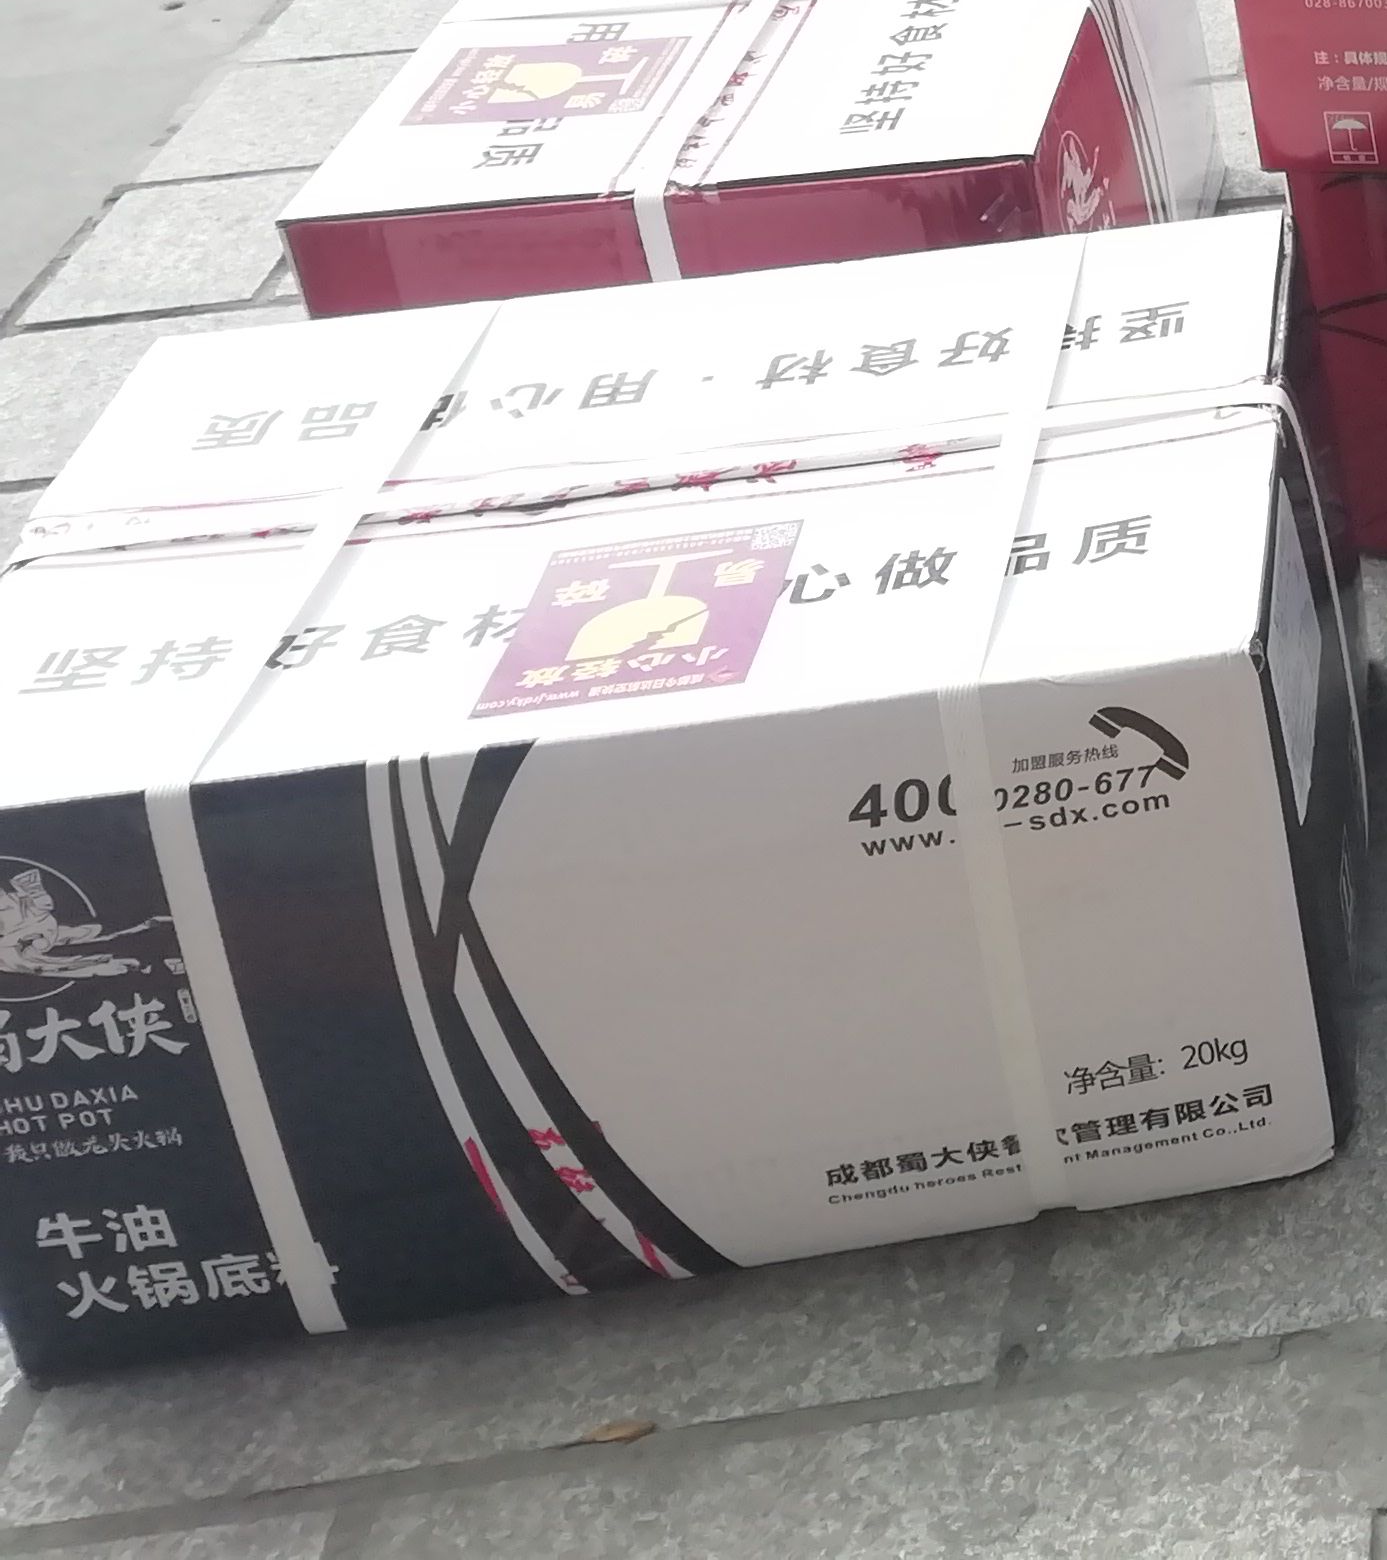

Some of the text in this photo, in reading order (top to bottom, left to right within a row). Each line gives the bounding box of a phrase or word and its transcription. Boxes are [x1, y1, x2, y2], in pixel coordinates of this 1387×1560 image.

[515, 644, 730, 688] 小心轻放
[1011, 744, 1120, 775] 加盟服务热线
[1181, 1036, 1250, 1073] 20kg
[0, 1083, 139, 1115] HU DAXIA
[57, 1107, 114, 1131] POT
[828, 1181, 910, 1205] Chengdu
[914, 1170, 977, 1190] heroes
[1085, 1131, 1199, 1163] Management
[36, 1203, 179, 1260] 牛油
